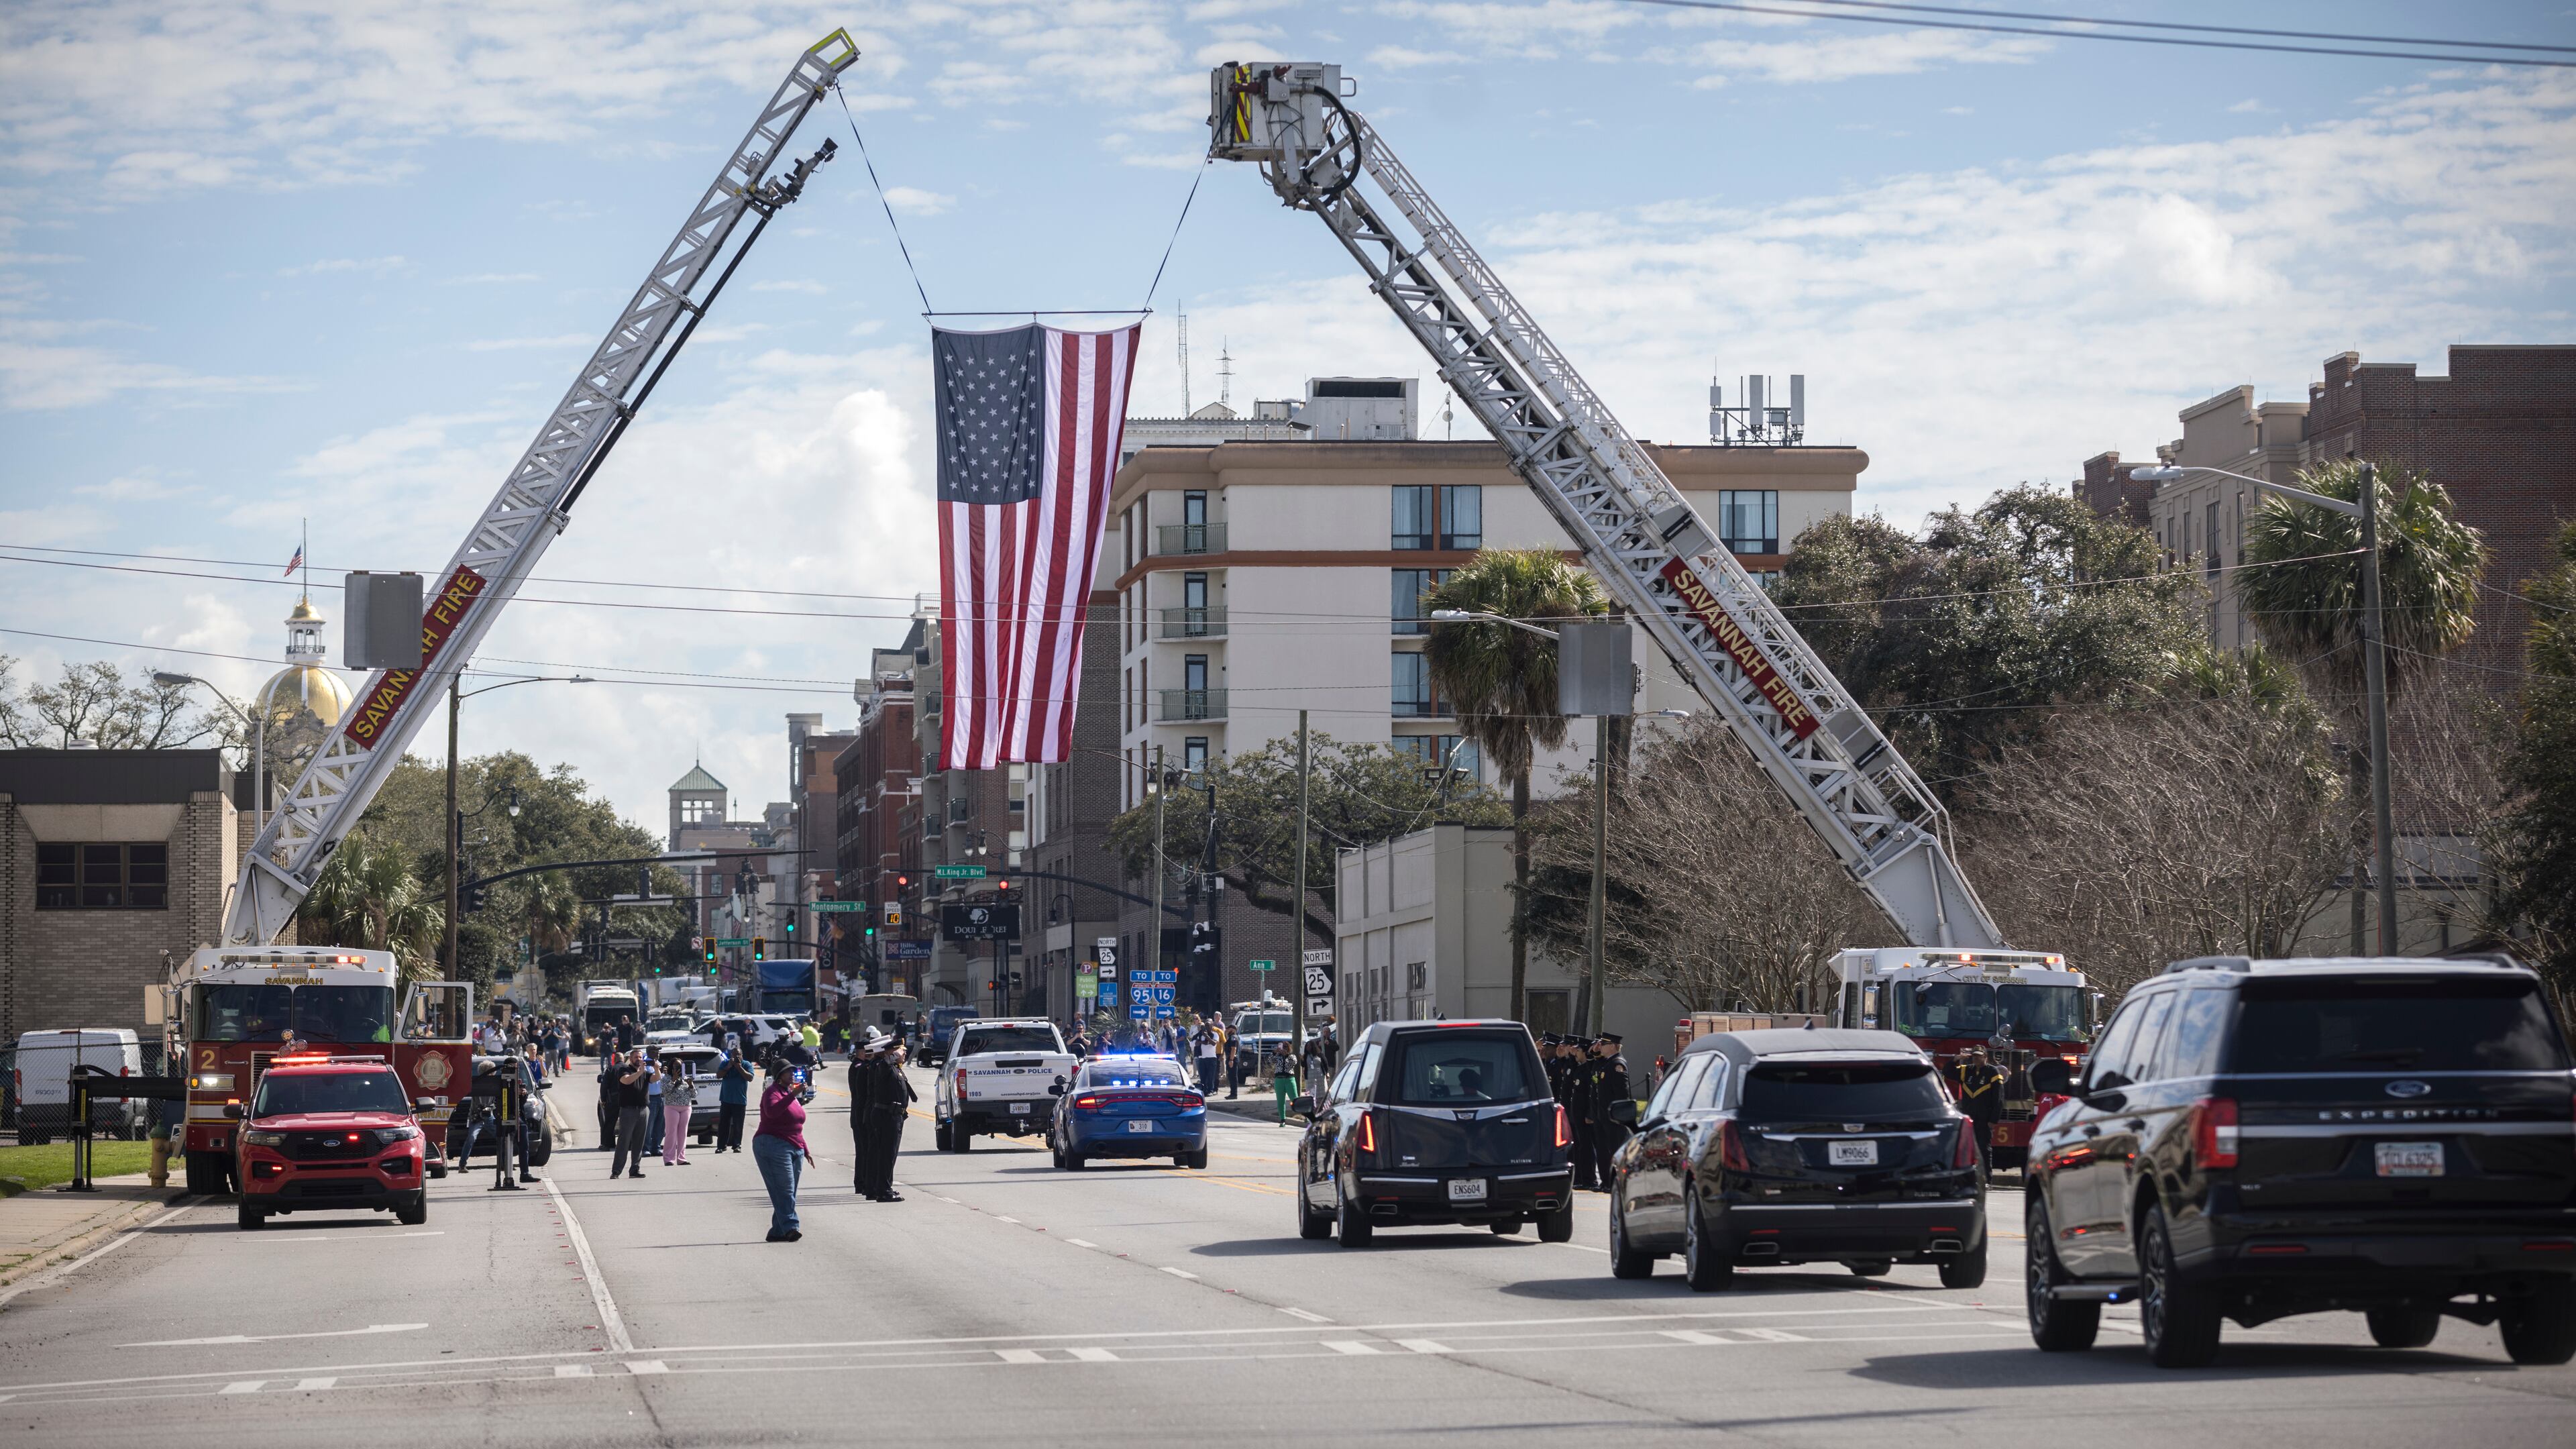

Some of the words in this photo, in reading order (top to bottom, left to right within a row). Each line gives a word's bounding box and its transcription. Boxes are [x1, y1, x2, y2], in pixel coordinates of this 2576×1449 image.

[1674, 570, 1768, 677] SAVANNAH
[1762, 676, 1810, 727] FIRE
[355, 627, 439, 739] SAVANH
[433, 572, 478, 625] FIRE
[811, 902, 850, 912] Montgomery
[854, 902, 863, 910] St.
[890, 913, 900, 923] 10
[1102, 952, 1111, 962] 25
[1304, 953, 1330, 962] NORTH
[1083, 965, 1091, 973] P
[1309, 973, 1324, 990] 25
[1992, 976, 2028, 984] SAVANNAH
[1134, 989, 1149, 1002] 95
[1159, 989, 1170, 1000] 16
[201, 1050, 215, 1069] 2
[2318, 1110, 2498, 1120] EXPEDITION
[1997, 1127, 2008, 1142] 5
[1454, 1185, 1480, 1195] ENS604
